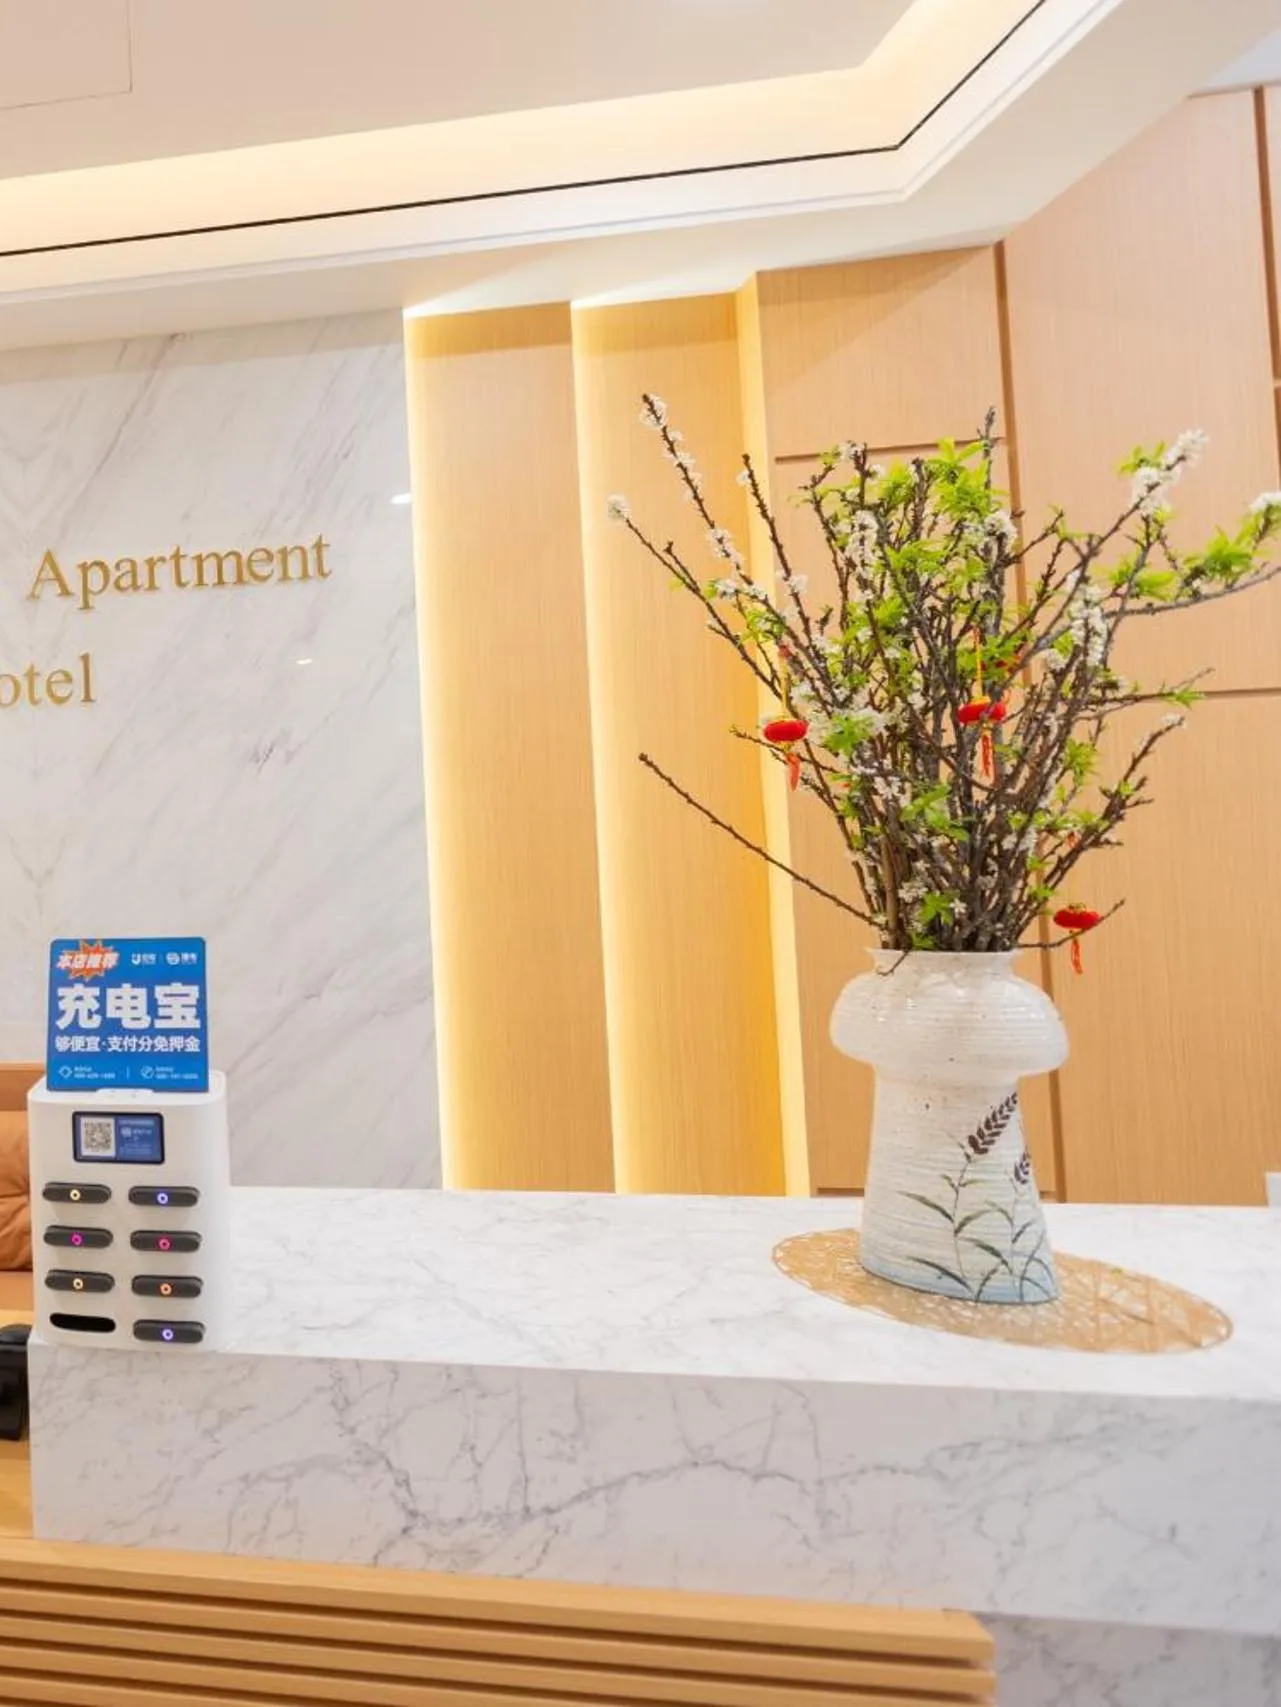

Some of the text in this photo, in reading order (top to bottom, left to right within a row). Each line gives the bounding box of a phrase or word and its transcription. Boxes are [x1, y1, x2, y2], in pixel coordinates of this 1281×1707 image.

[27, 534, 332, 610] Apartment
[55, 982, 201, 1030] 充电宝
